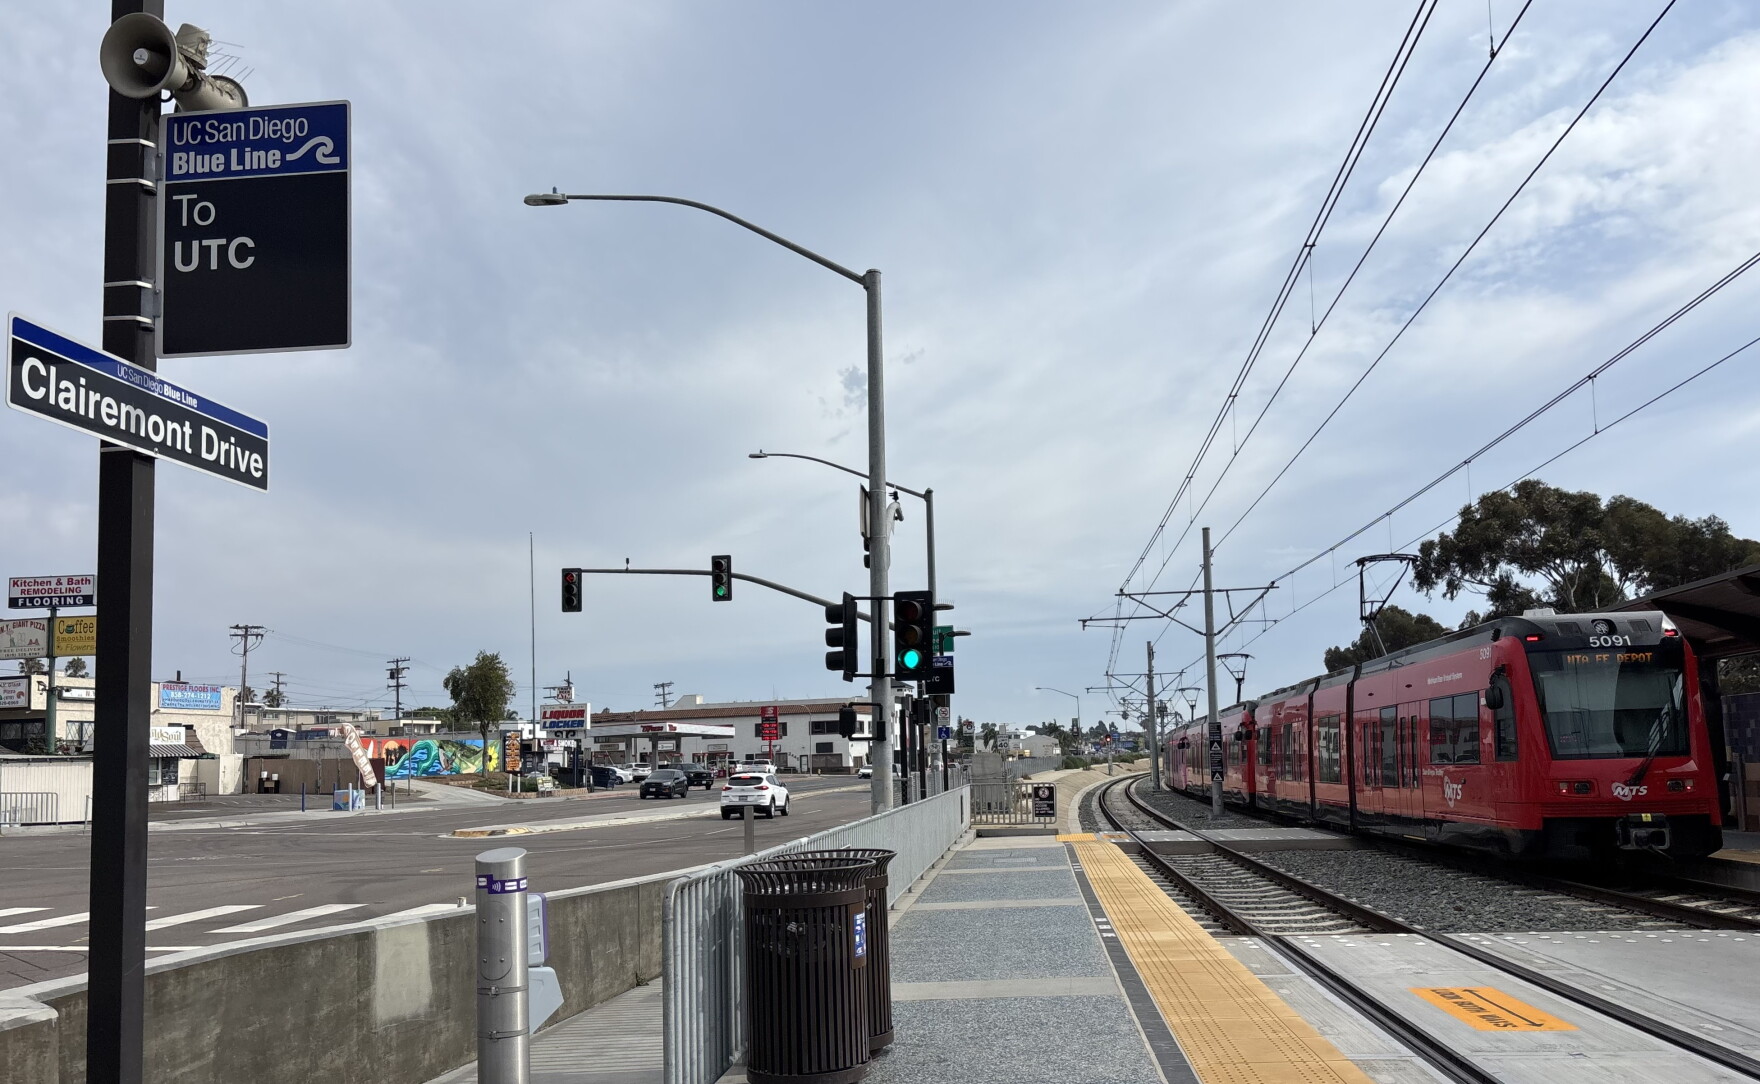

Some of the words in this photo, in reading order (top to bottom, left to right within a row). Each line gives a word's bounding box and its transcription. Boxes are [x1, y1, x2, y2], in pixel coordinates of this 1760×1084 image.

[173, 120, 201, 146] UC
[205, 118, 245, 143] San
[249, 116, 309, 142] Diego
[173, 150, 225, 175] Blue
[230, 147, 281, 171] Line
[173, 194, 216, 227] To
[174, 236, 256, 272] UTC
[117, 364, 128, 379] UC
[128, 368, 143, 386] San
[143, 374, 163, 394] Diego
[163, 384, 181, 401] Blue
[181, 391, 198, 408] Line
[21, 356, 193, 454] Clairemont
[201, 425, 264, 478] Drive
[12, 578, 52, 588] Kitchen
[55, 577, 63, 586] &
[67, 577, 91, 586] Bath
[20, 586, 82, 596] REMODELING
[18, 596, 84, 607] FLOORING
[12, 620, 28, 630] GIANT
[30, 620, 46, 632] PIZZA
[1589, 635, 1632, 648] 5091
[1480, 647, 1492, 660] 5091
[1616, 652, 1653, 664] DEPOT
[542, 709, 585, 720] LIQUOR
[542, 720, 585, 729] LOCKER
[1444, 783, 1462, 800] MTS
[1612, 785, 1648, 796] MTS
[1452, 1001, 1491, 1013] BOTH
[1476, 1014, 1518, 1028] WAYS
